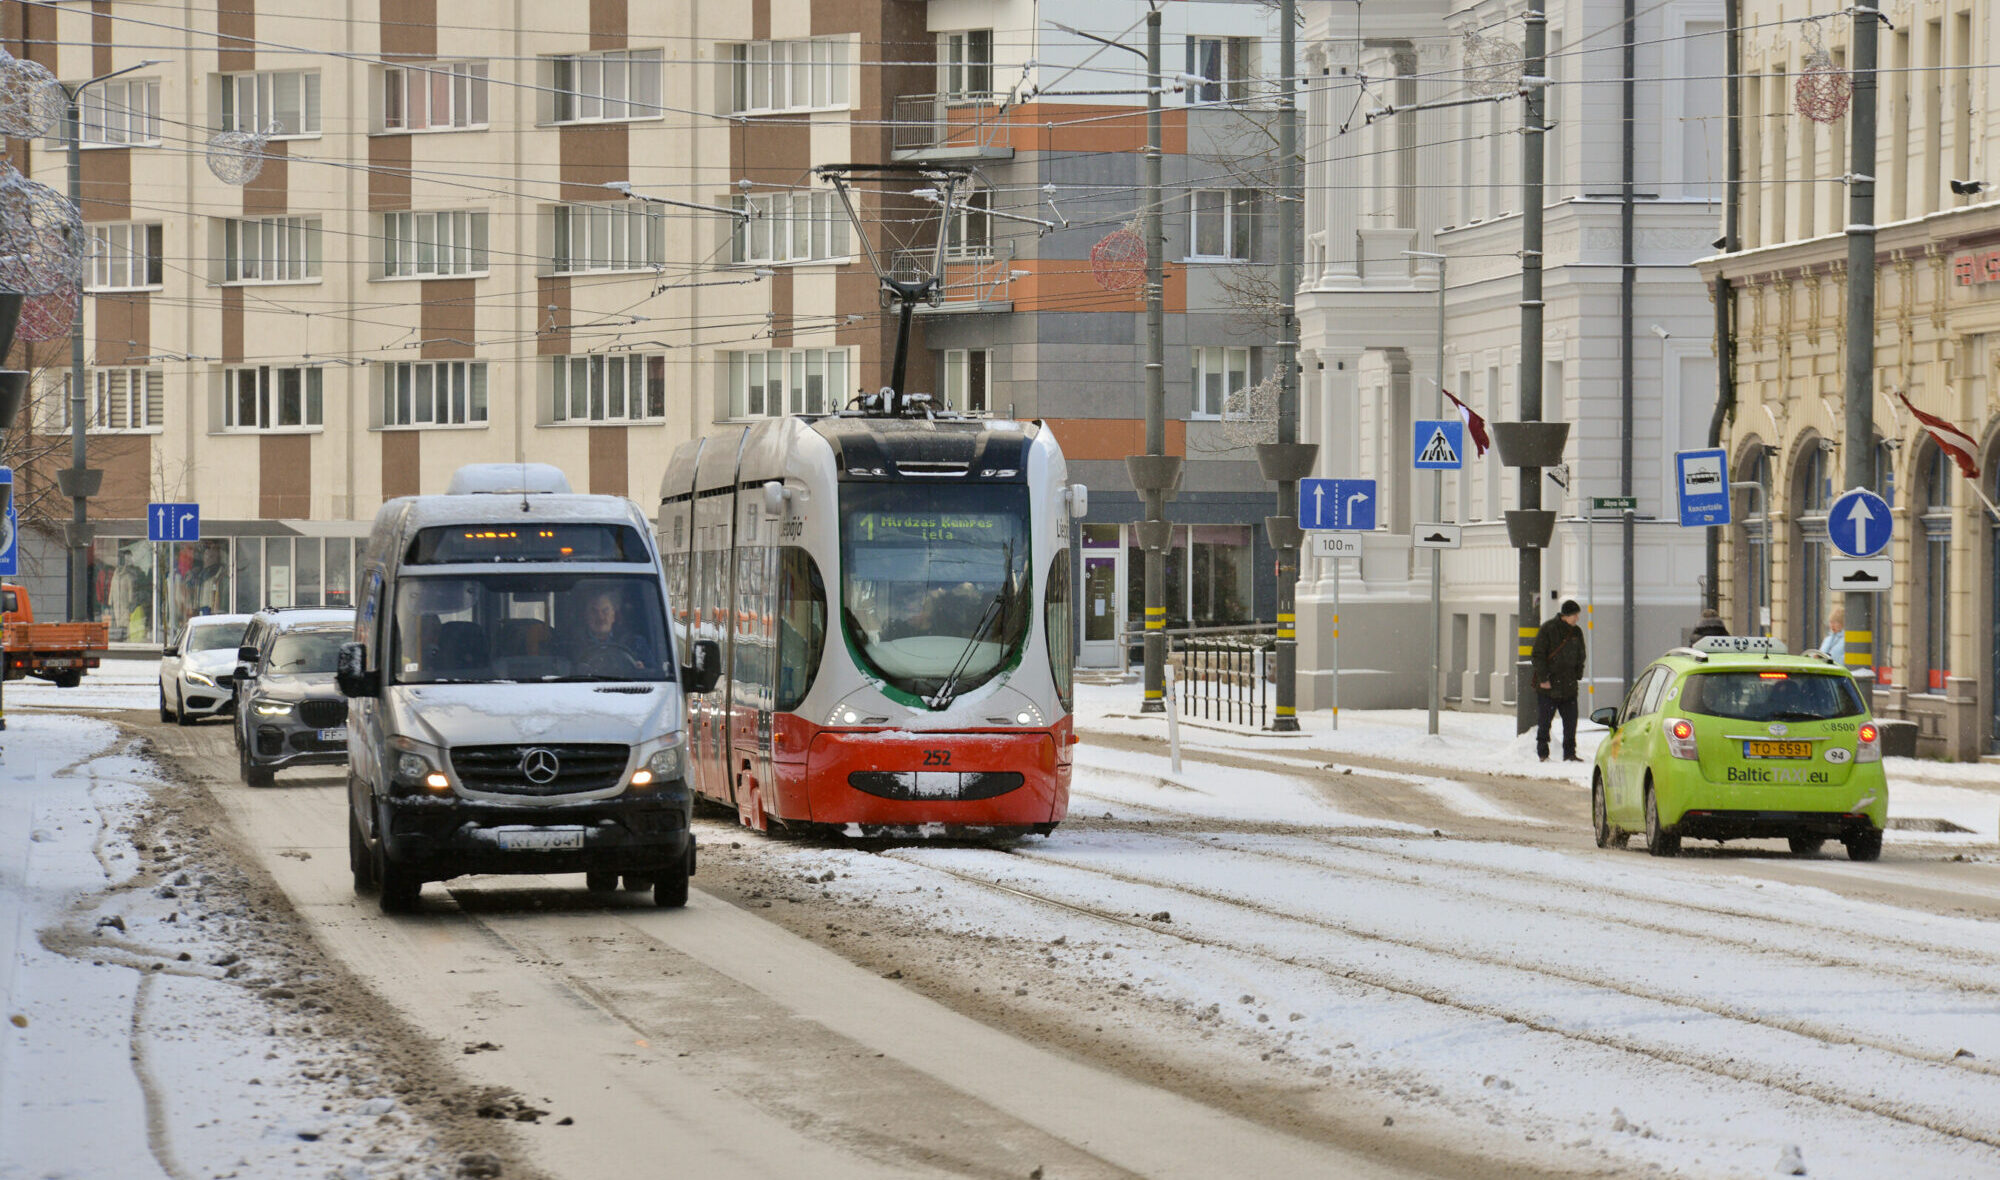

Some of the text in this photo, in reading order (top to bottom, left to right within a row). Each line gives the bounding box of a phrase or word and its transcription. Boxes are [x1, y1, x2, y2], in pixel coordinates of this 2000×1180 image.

[860, 514, 873, 540] 1
[922, 529, 953, 540] iela
[1323, 539, 1343, 551] 100
[1831, 723, 1855, 732] 8500
[923, 750, 951, 766] 252
[1831, 751, 1844, 760] 94
[1727, 767, 1829, 783] BalticTAXI.eu
